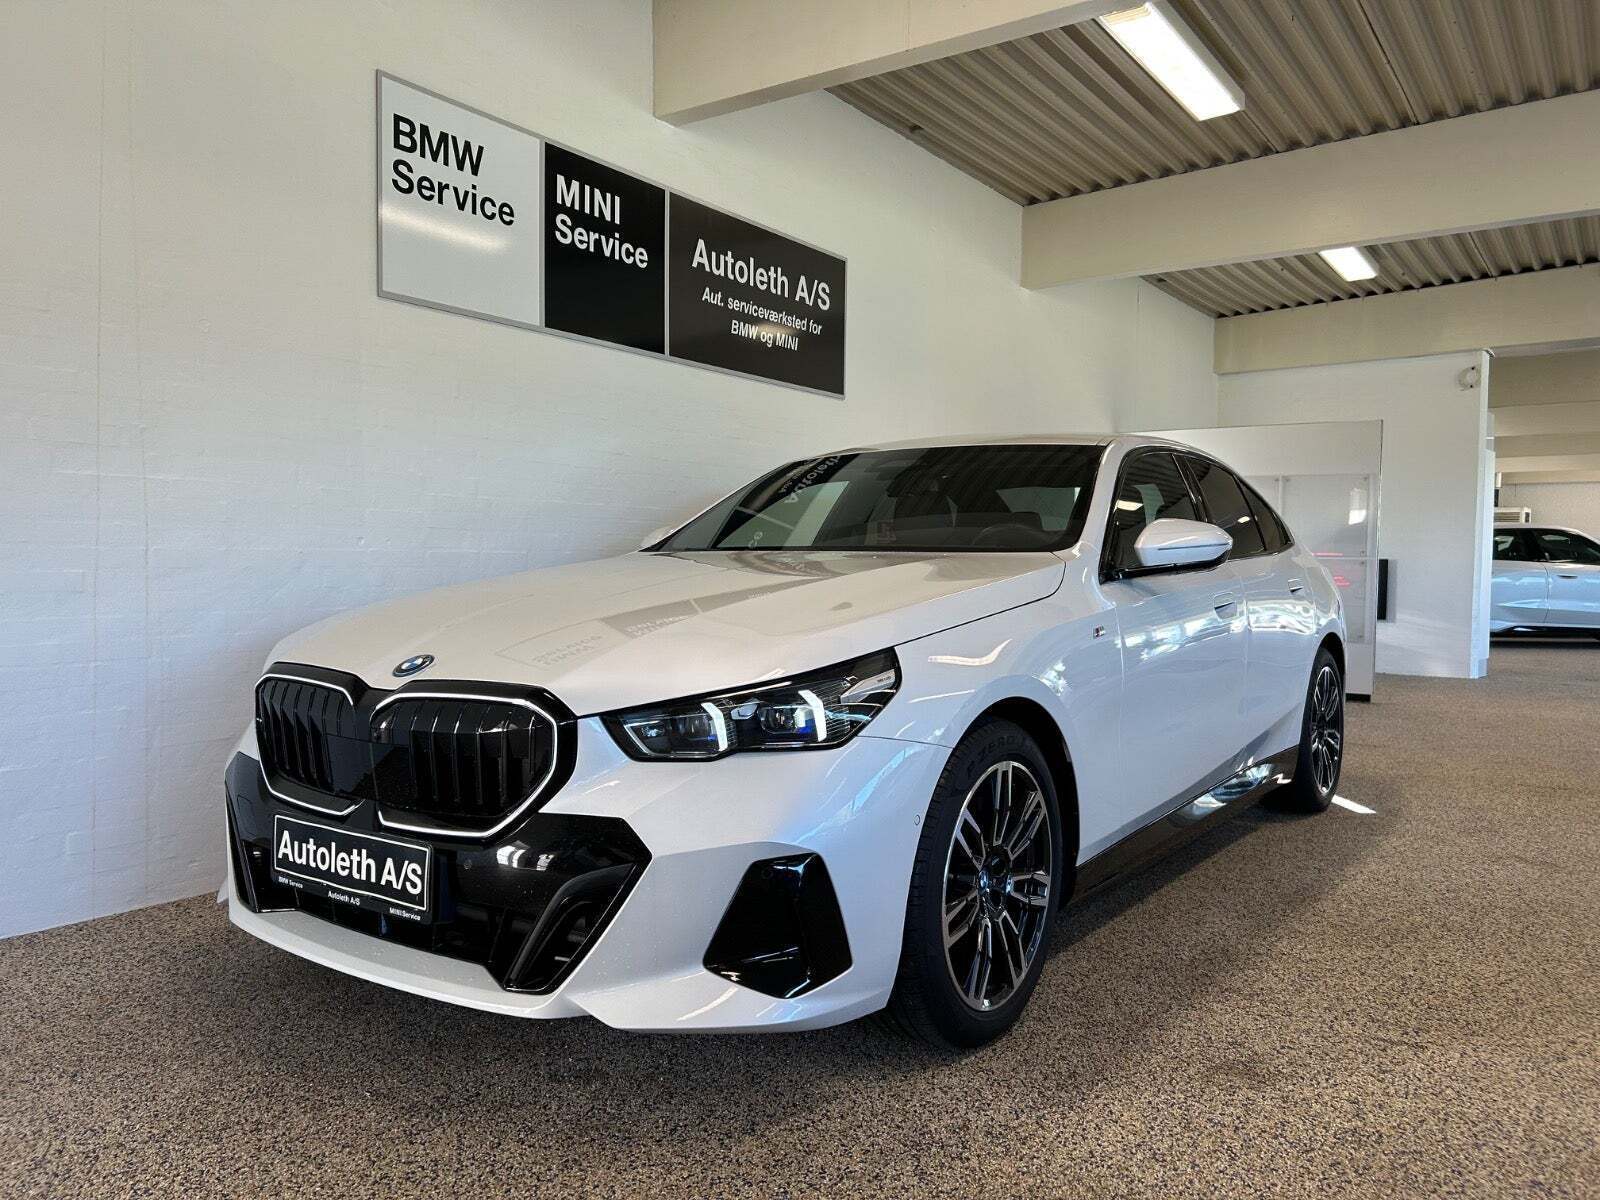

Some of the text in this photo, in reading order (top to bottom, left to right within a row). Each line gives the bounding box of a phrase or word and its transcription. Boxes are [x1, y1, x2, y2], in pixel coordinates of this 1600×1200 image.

[393, 113, 484, 176] BMW
[391, 159, 515, 226] Service
[555, 174, 621, 224] MINI
[554, 213, 649, 269] Service
[691, 238, 831, 311] Autoleth A/S
[702, 286, 823, 336] Aut. serviceværksted for
[730, 319, 799, 350] BMW og MINI
[277, 830, 422, 895] Autoleth A/S
[289, 879, 303, 889] Service
[328, 891, 360, 906] Autoleth A/S
[402, 911, 421, 921] Service
